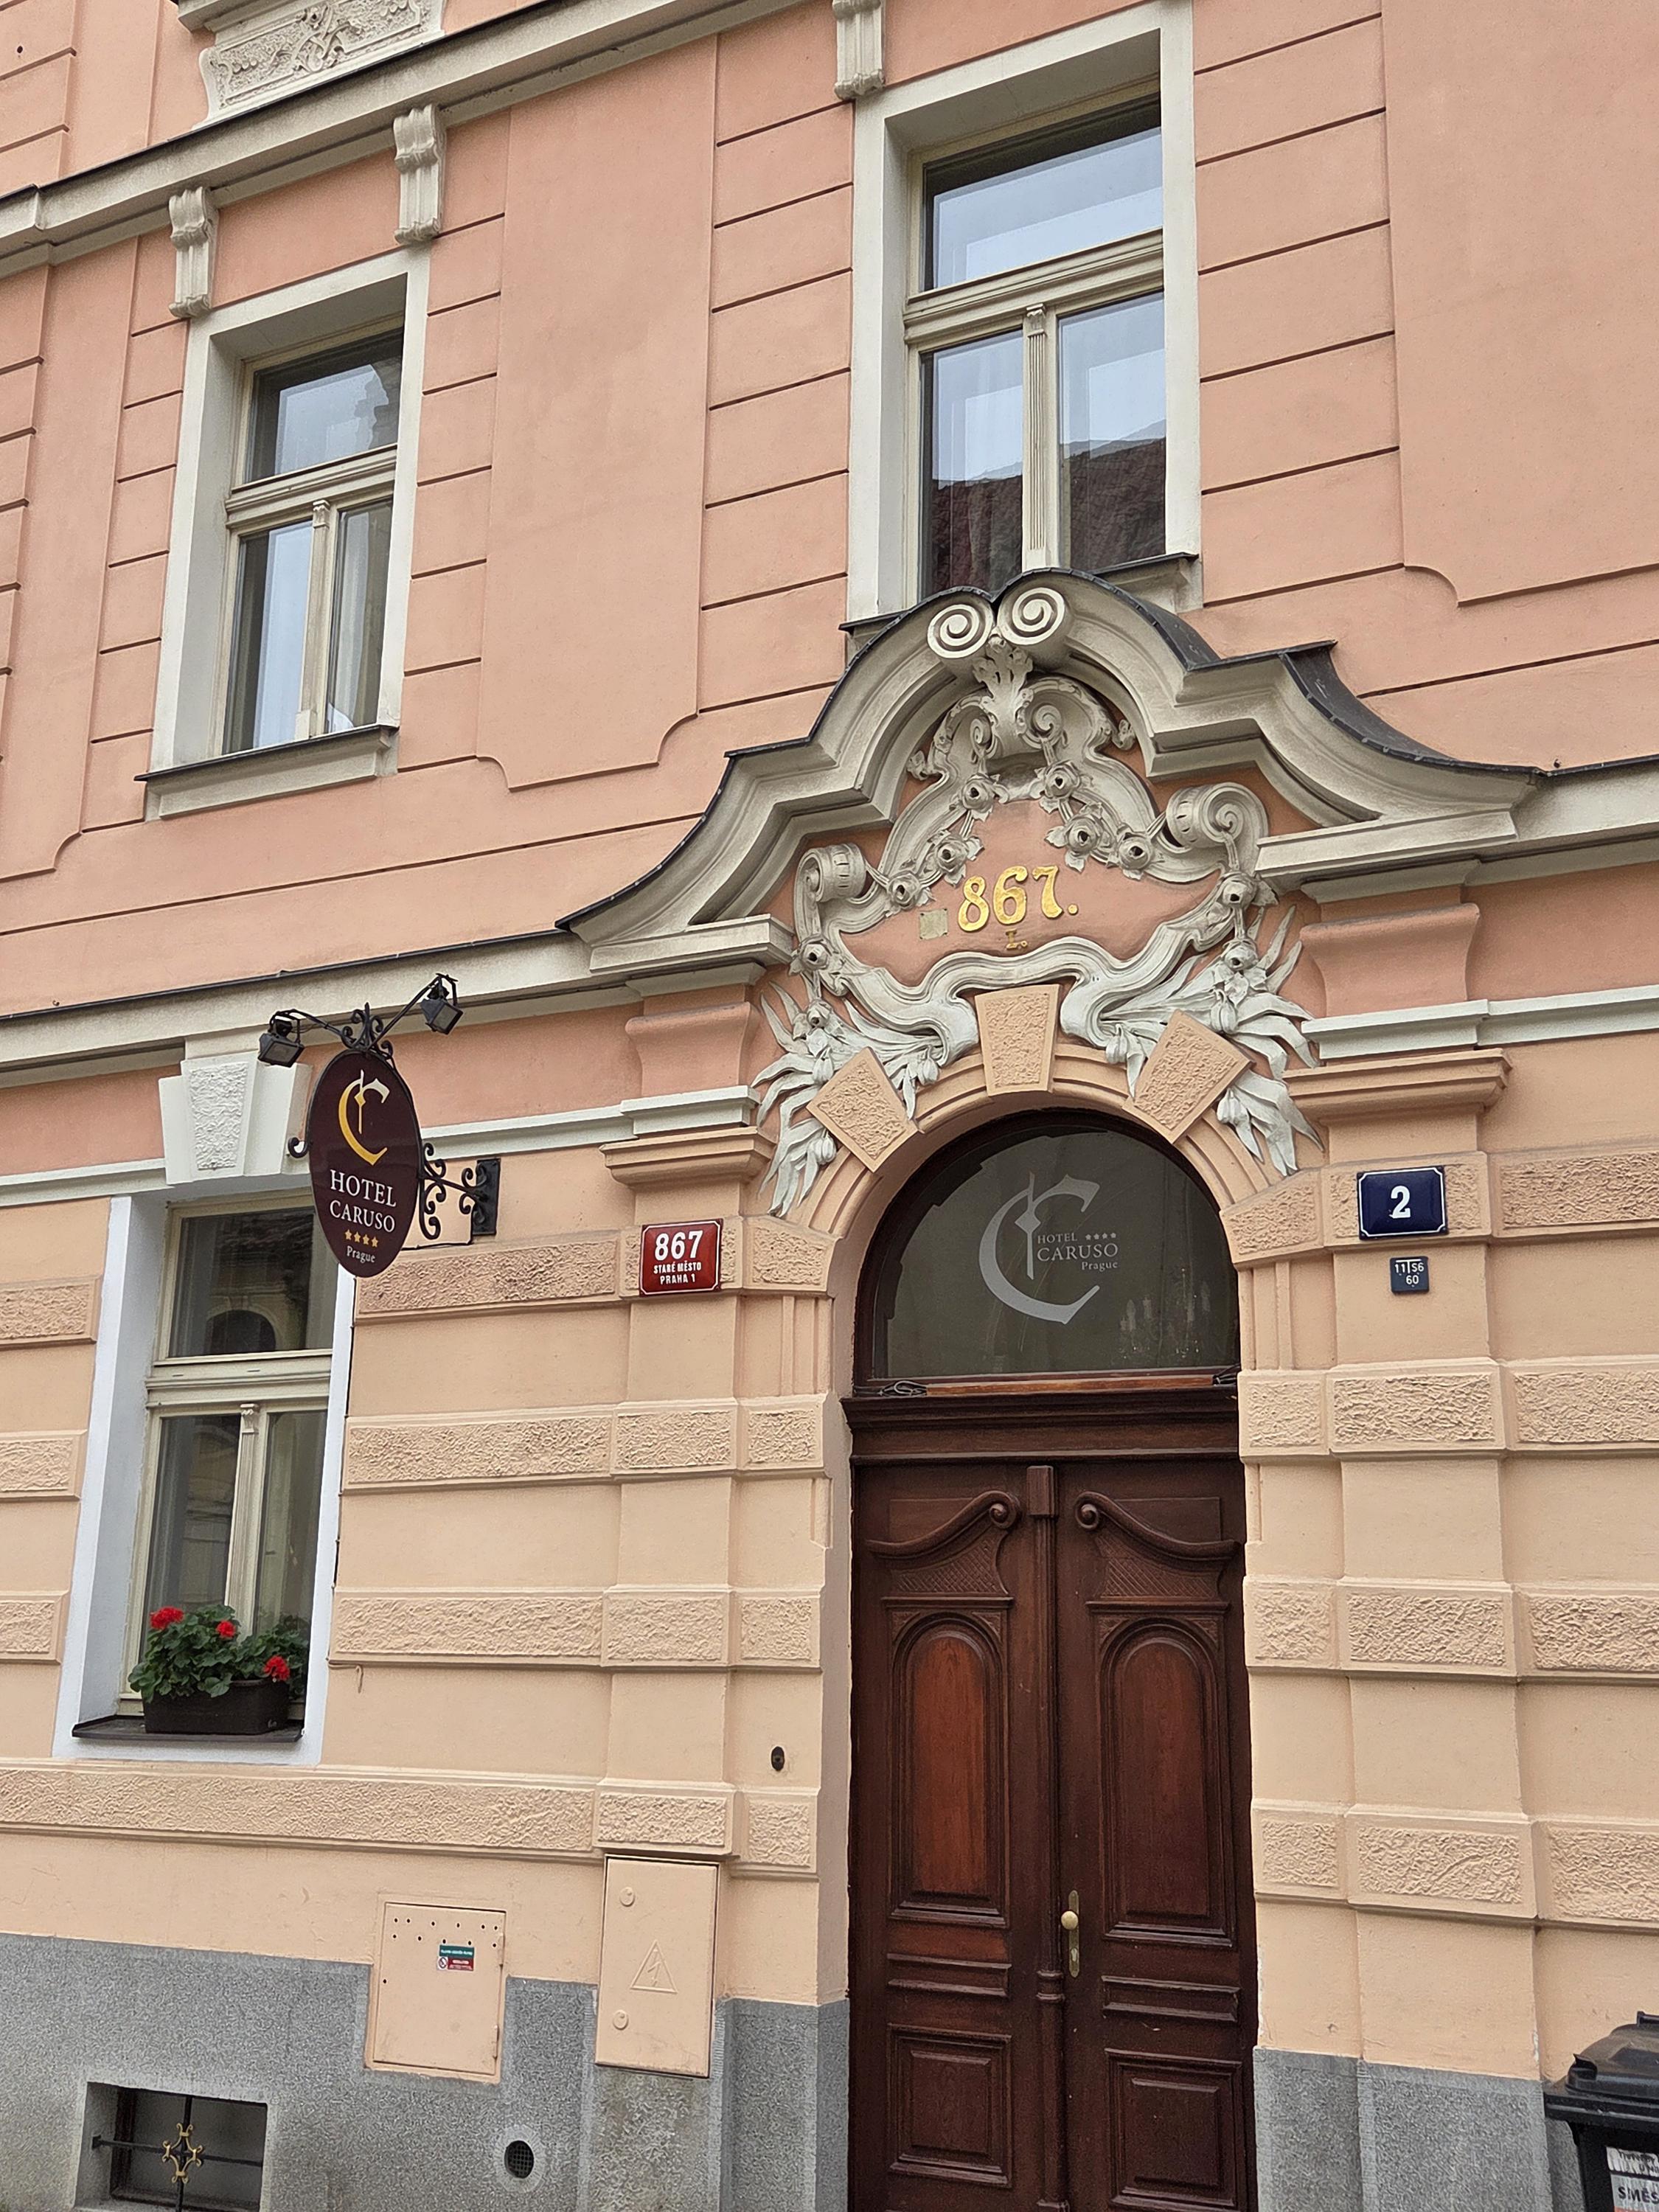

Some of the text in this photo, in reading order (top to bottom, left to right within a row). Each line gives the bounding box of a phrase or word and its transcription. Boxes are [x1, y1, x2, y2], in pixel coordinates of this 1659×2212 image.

[330, 1169, 397, 1208] HOTEL
[1389, 1185, 1411, 1219] 2
[330, 1200, 395, 1233] CARUSO
[655, 1230, 703, 1261] 867
[1037, 1232, 1078, 1244] HOTEL
[347, 1245, 376, 1264] Prague
[1037, 1242, 1119, 1262] CARUSO
[653, 1259, 702, 1274] STARÉ MĚSTO
[1082, 1261, 1119, 1273] Prague
[660, 1273, 696, 1285] PRAHA 1
[1406, 1275, 1419, 1284] 60
